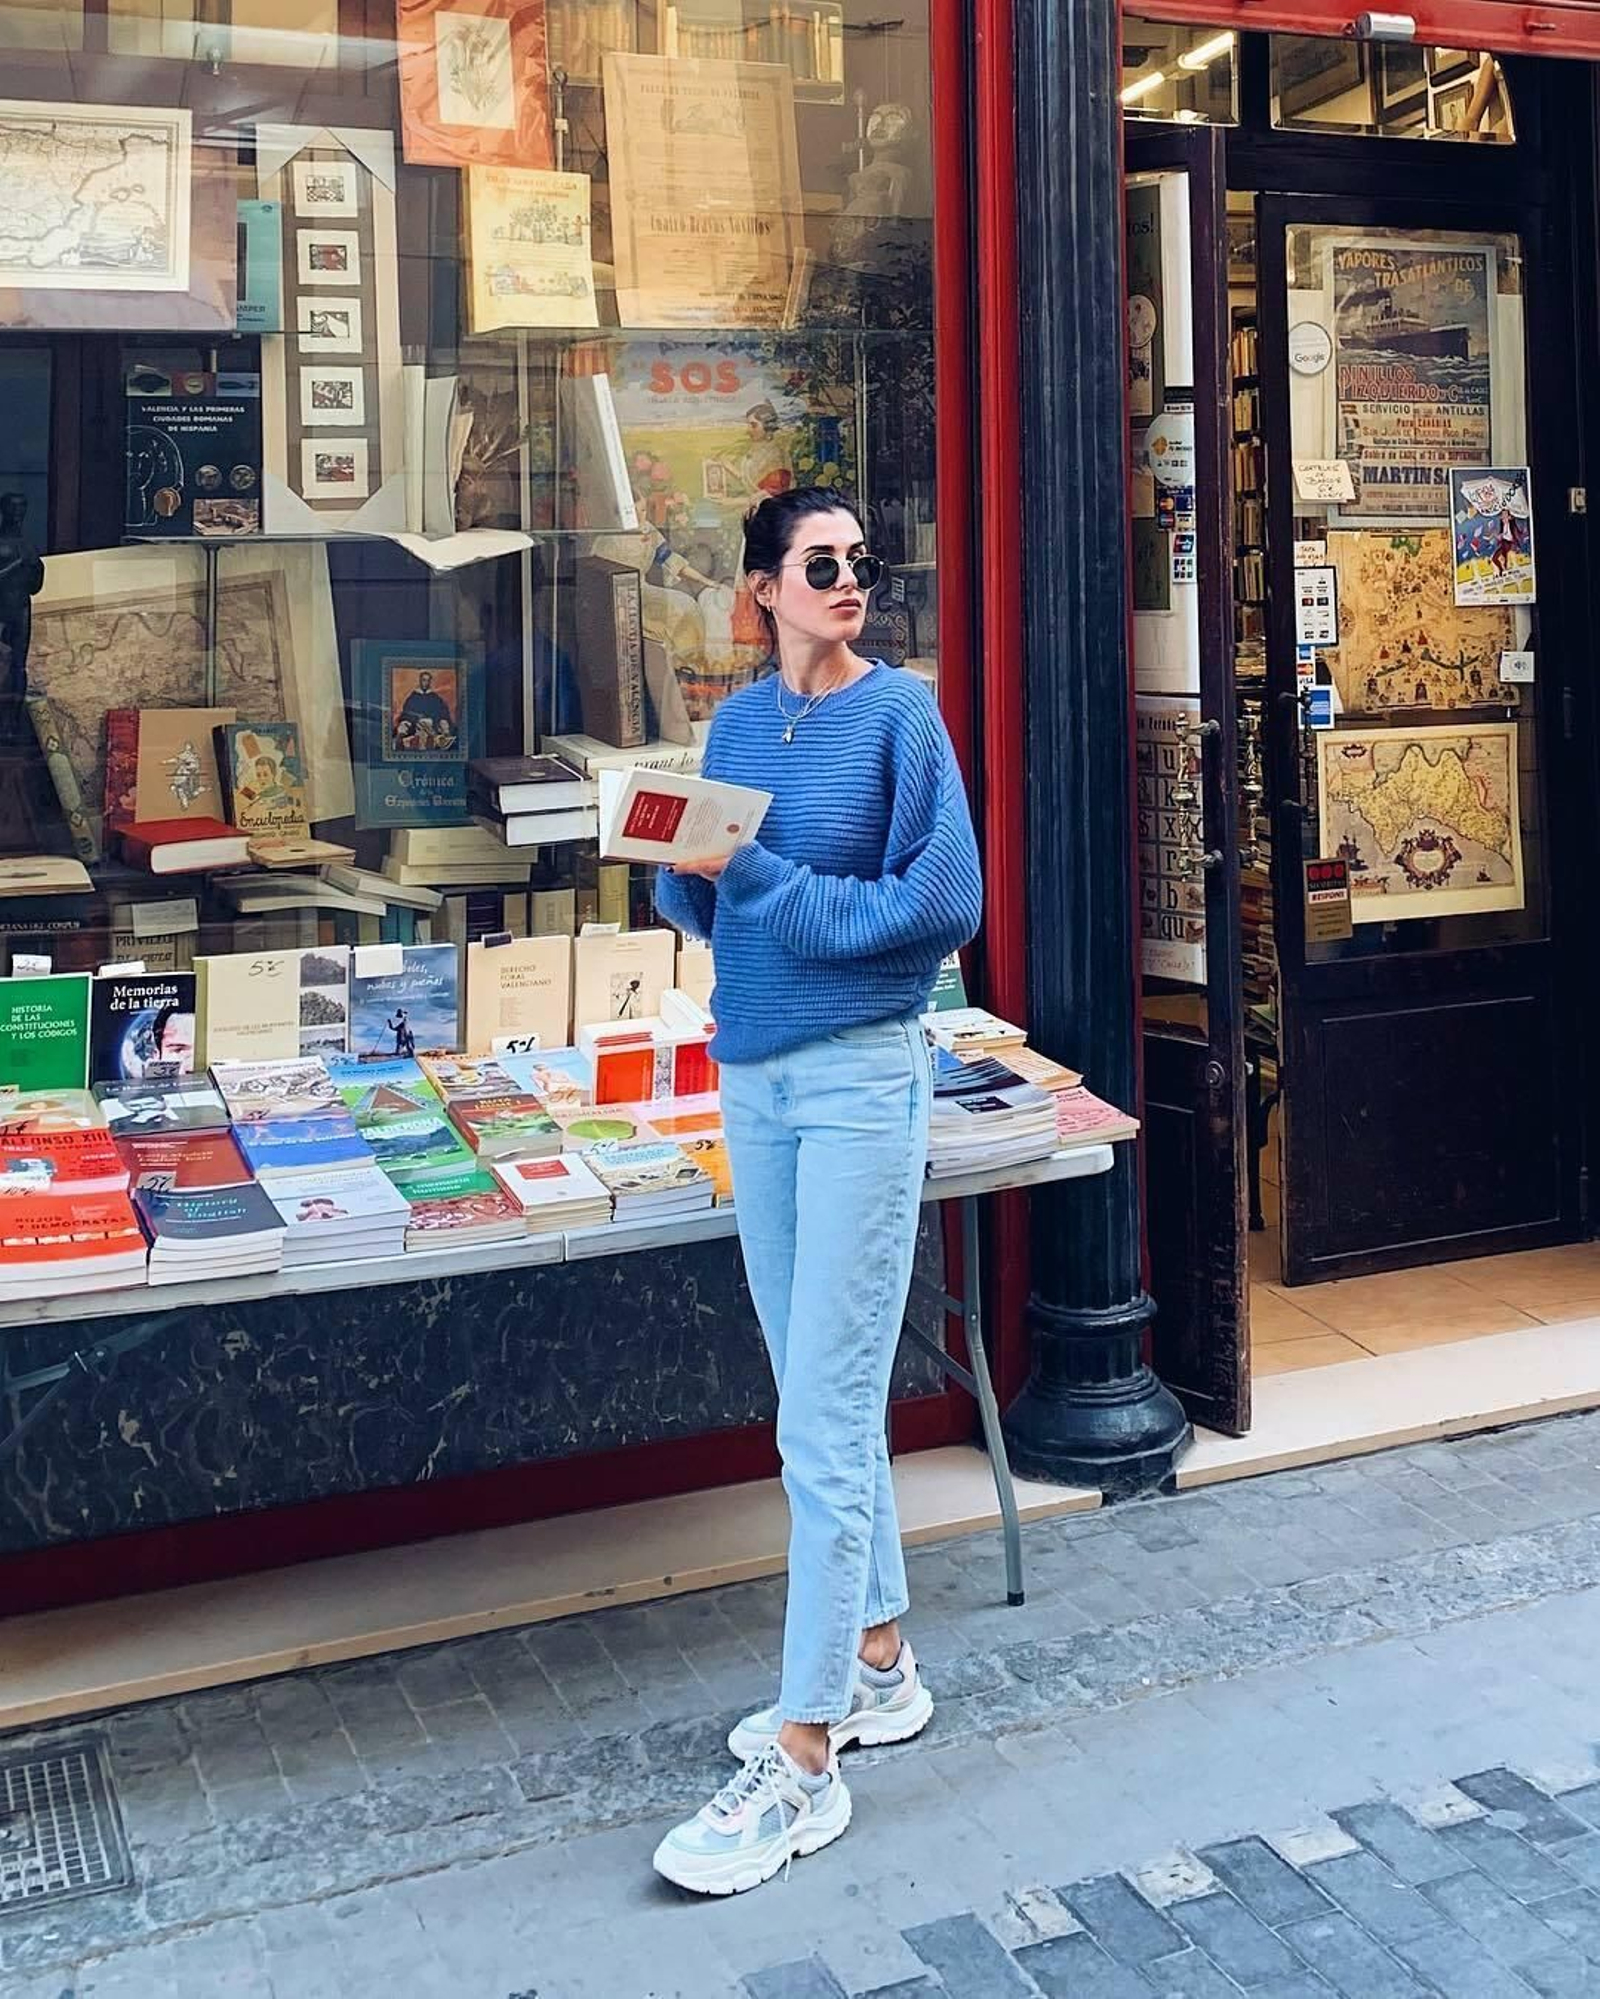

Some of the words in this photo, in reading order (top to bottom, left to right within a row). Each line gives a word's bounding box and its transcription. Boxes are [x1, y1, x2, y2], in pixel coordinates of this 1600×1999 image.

[1338, 251, 1396, 271] VAPORES
[1294, 353, 1325, 364] Google
[1362, 403, 1411, 415] SERVICIO
[1436, 406, 1485, 416] ANTILLAS
[193, 415, 234, 423] ROMANAS
[630, 672, 640, 735] VALENCIA
[501, 965, 537, 973] DERECHO
[500, 979, 552, 989] VALENCIANO
[113, 983, 178, 998] Memorias
[11, 1005, 53, 1014] HISTORIA
[109, 998, 127, 1011] de
[128, 997, 140, 1010] la
[143, 997, 179, 1010] tierra
[24, 1014, 41, 1022] LAS
[0, 1020, 75, 1032] CONSTITUCIONES
[11, 1032, 17, 1040] Y
[19, 1031, 36, 1040] LOS
[1, 1135, 74, 1146] ALFONSO
[81, 1131, 108, 1143] XIII
